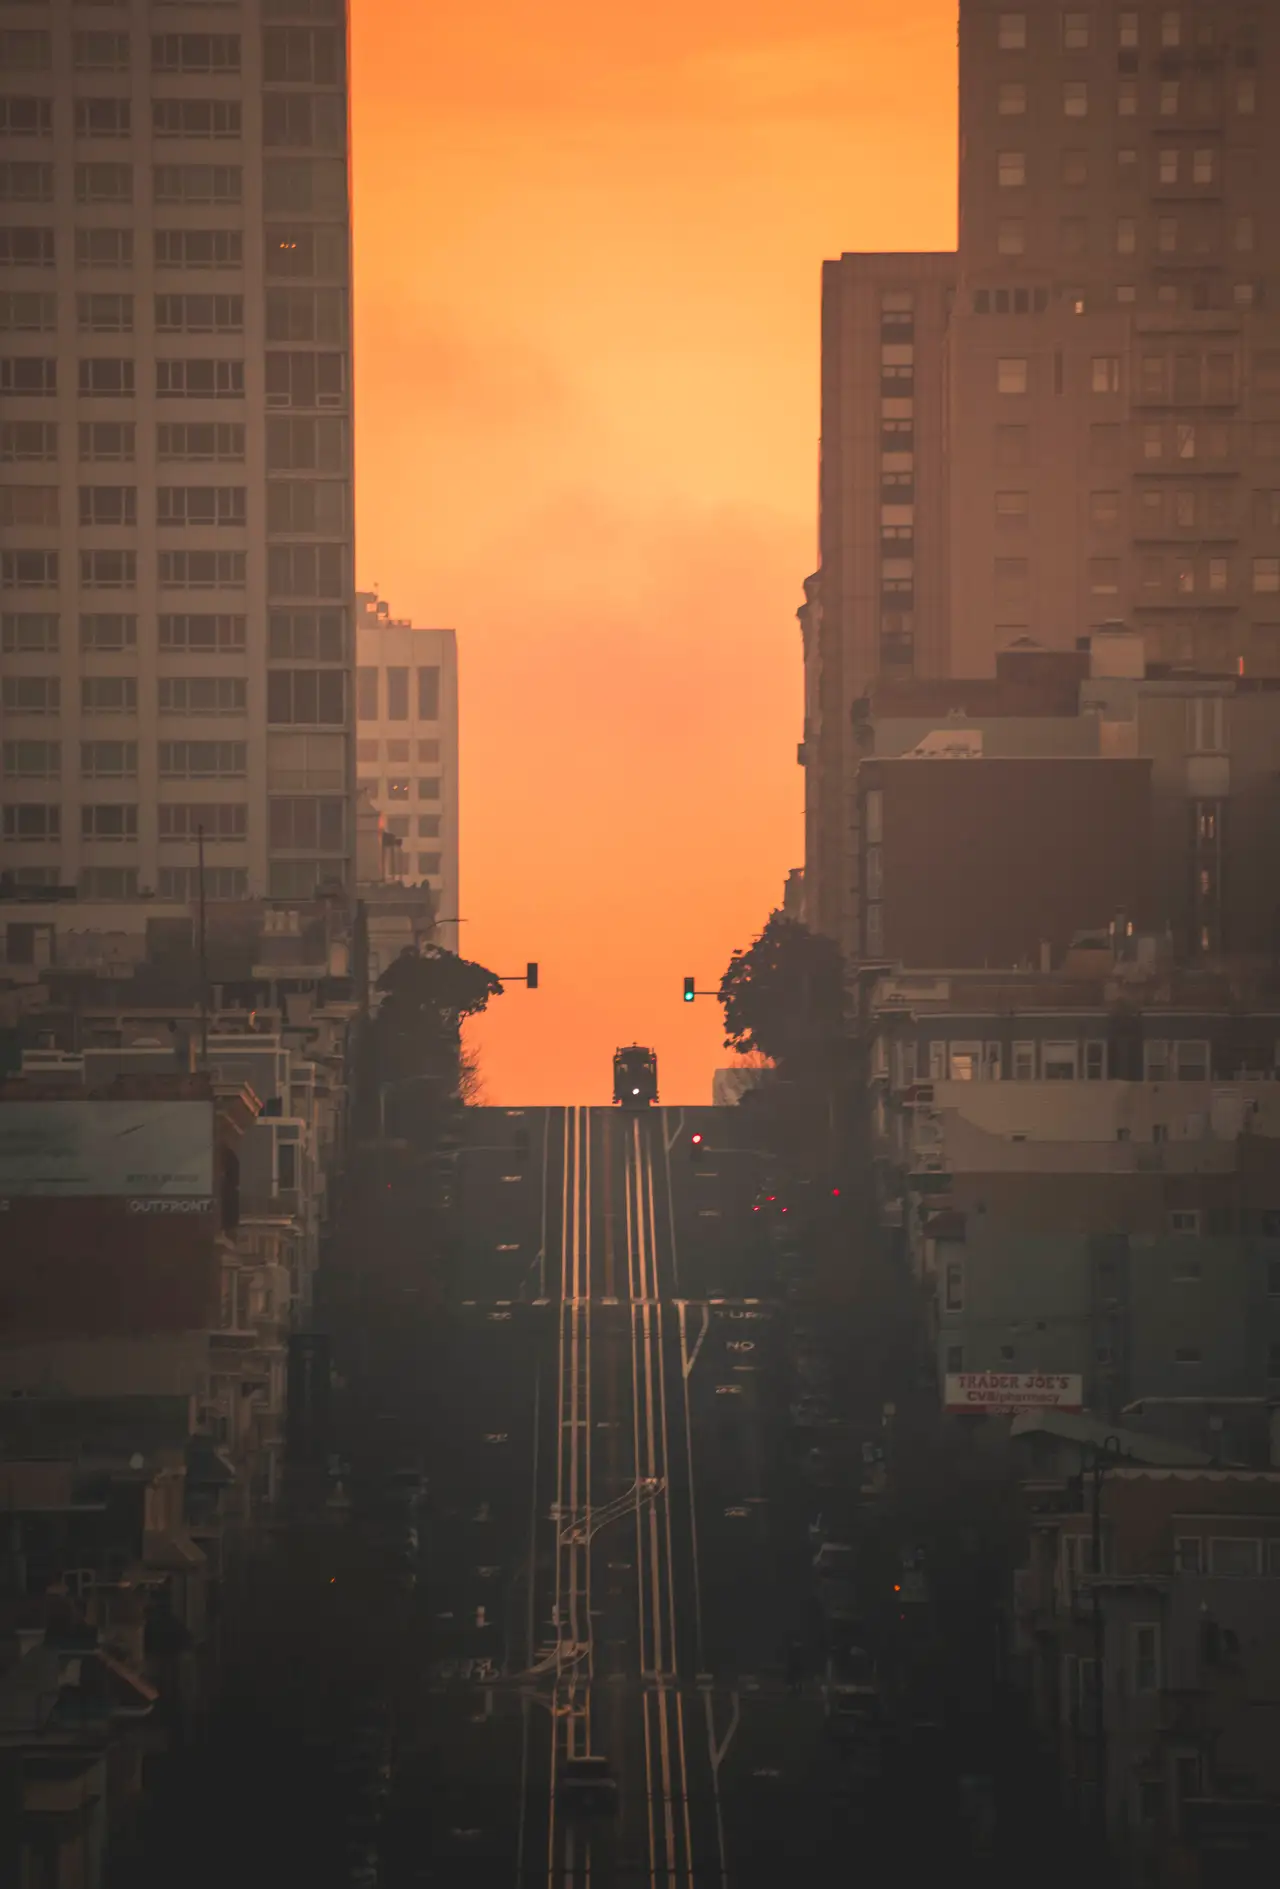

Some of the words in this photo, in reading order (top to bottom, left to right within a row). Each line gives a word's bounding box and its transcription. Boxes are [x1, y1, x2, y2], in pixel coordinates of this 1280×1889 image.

[726, 1341, 756, 1352] NO
[959, 1376, 1019, 1389] TRADER
[1024, 1376, 1070, 1389] JOE'S
